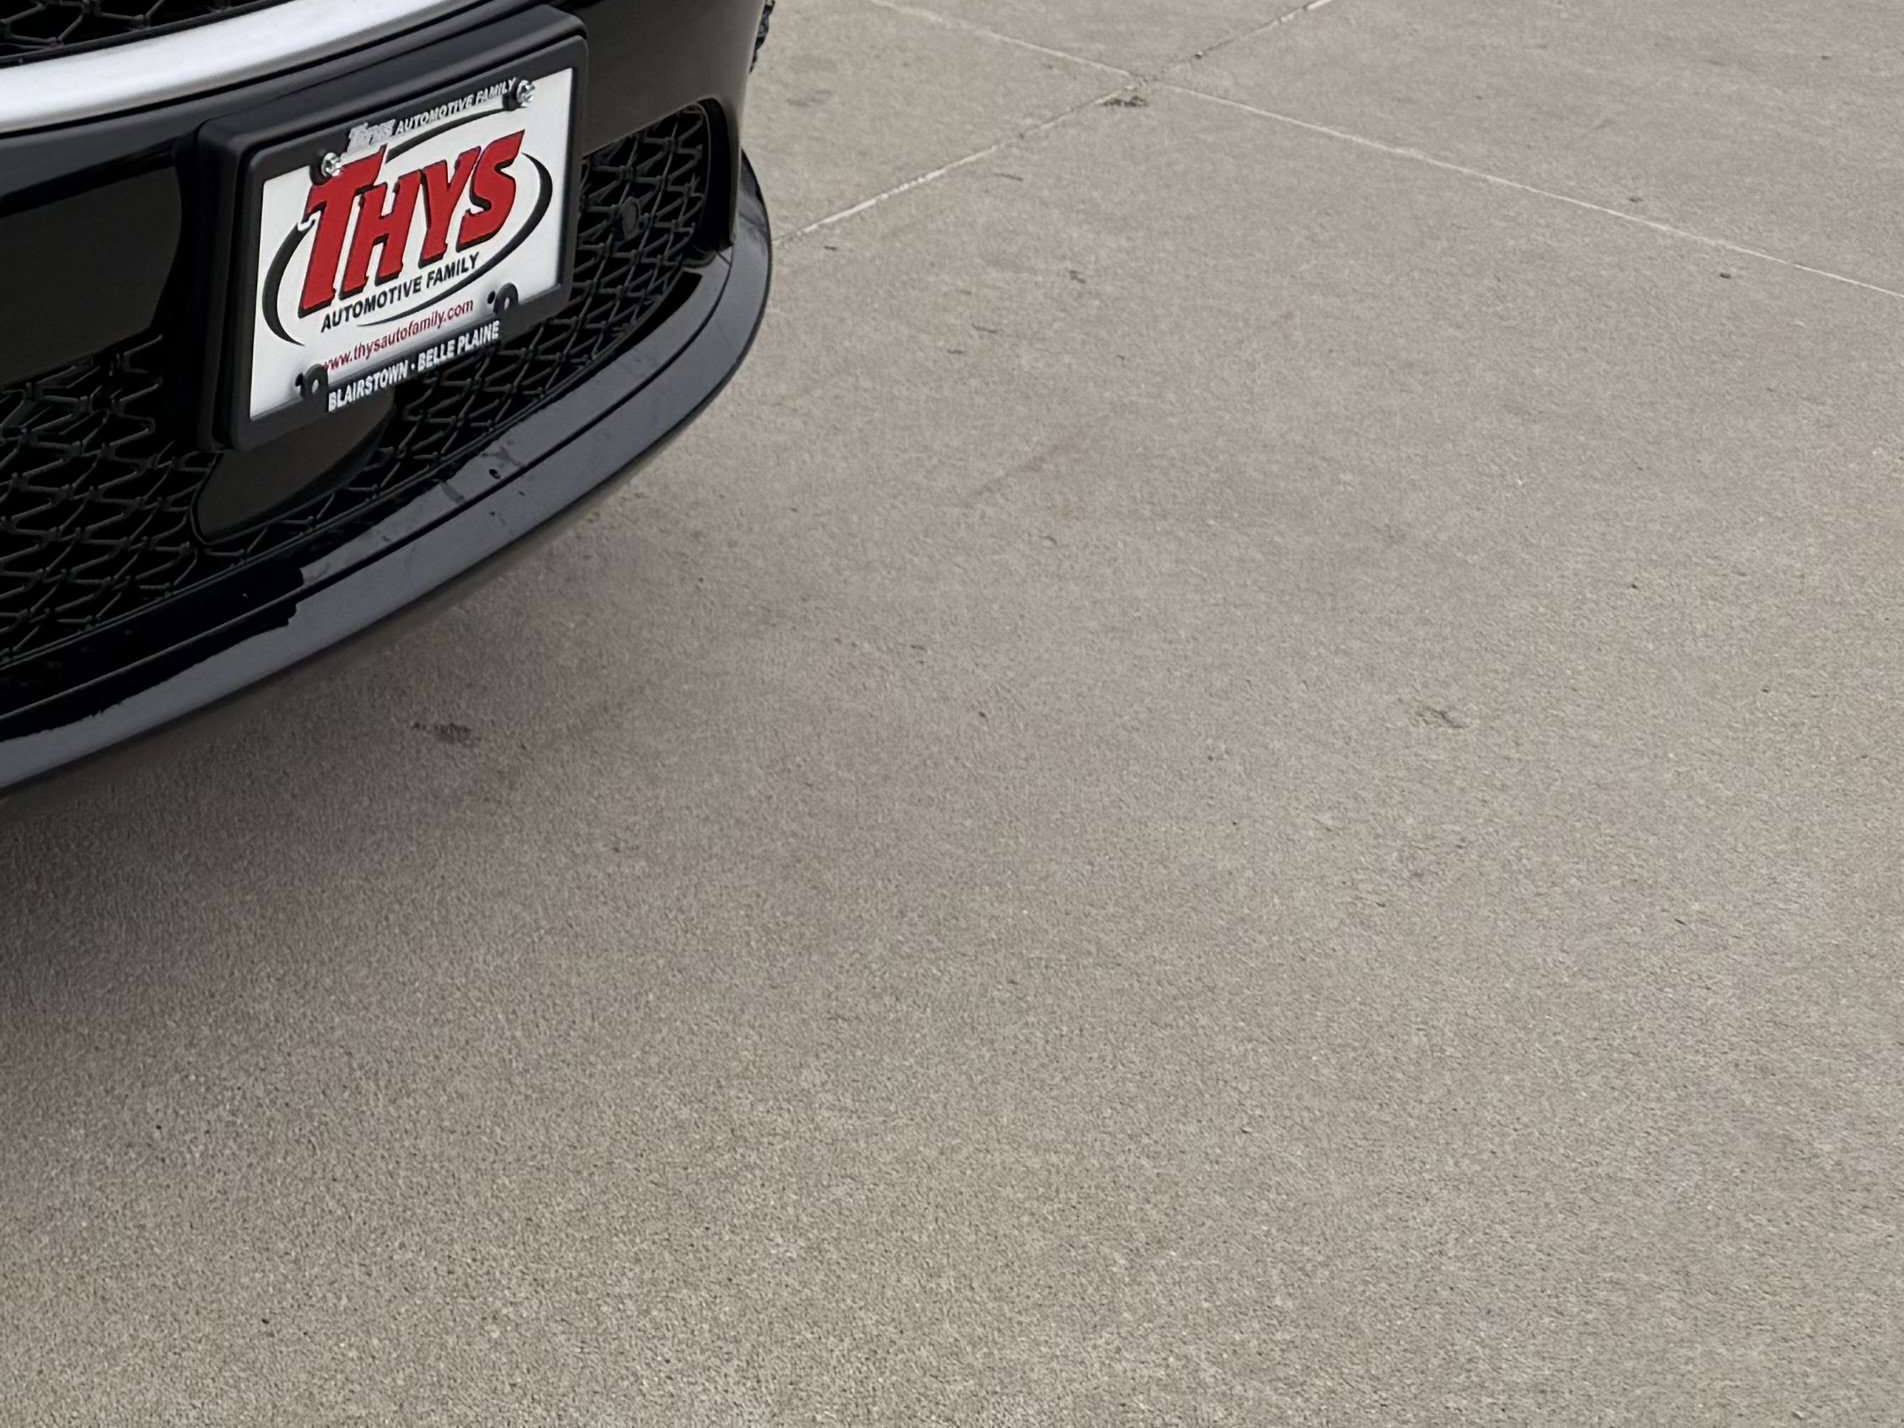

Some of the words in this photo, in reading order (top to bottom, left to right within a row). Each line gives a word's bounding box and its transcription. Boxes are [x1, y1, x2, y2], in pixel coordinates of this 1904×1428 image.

[395, 96, 474, 137] AUTOMOTIVE
[475, 76, 517, 106] FAMILY
[297, 129, 526, 319] THYS
[320, 275, 423, 333] AUTOMOTIVE
[425, 251, 480, 289] FAMILY
[327, 359, 409, 413] BLAIRSTOWN
[417, 338, 456, 373] BELLE
[456, 320, 501, 356] PLAINE
